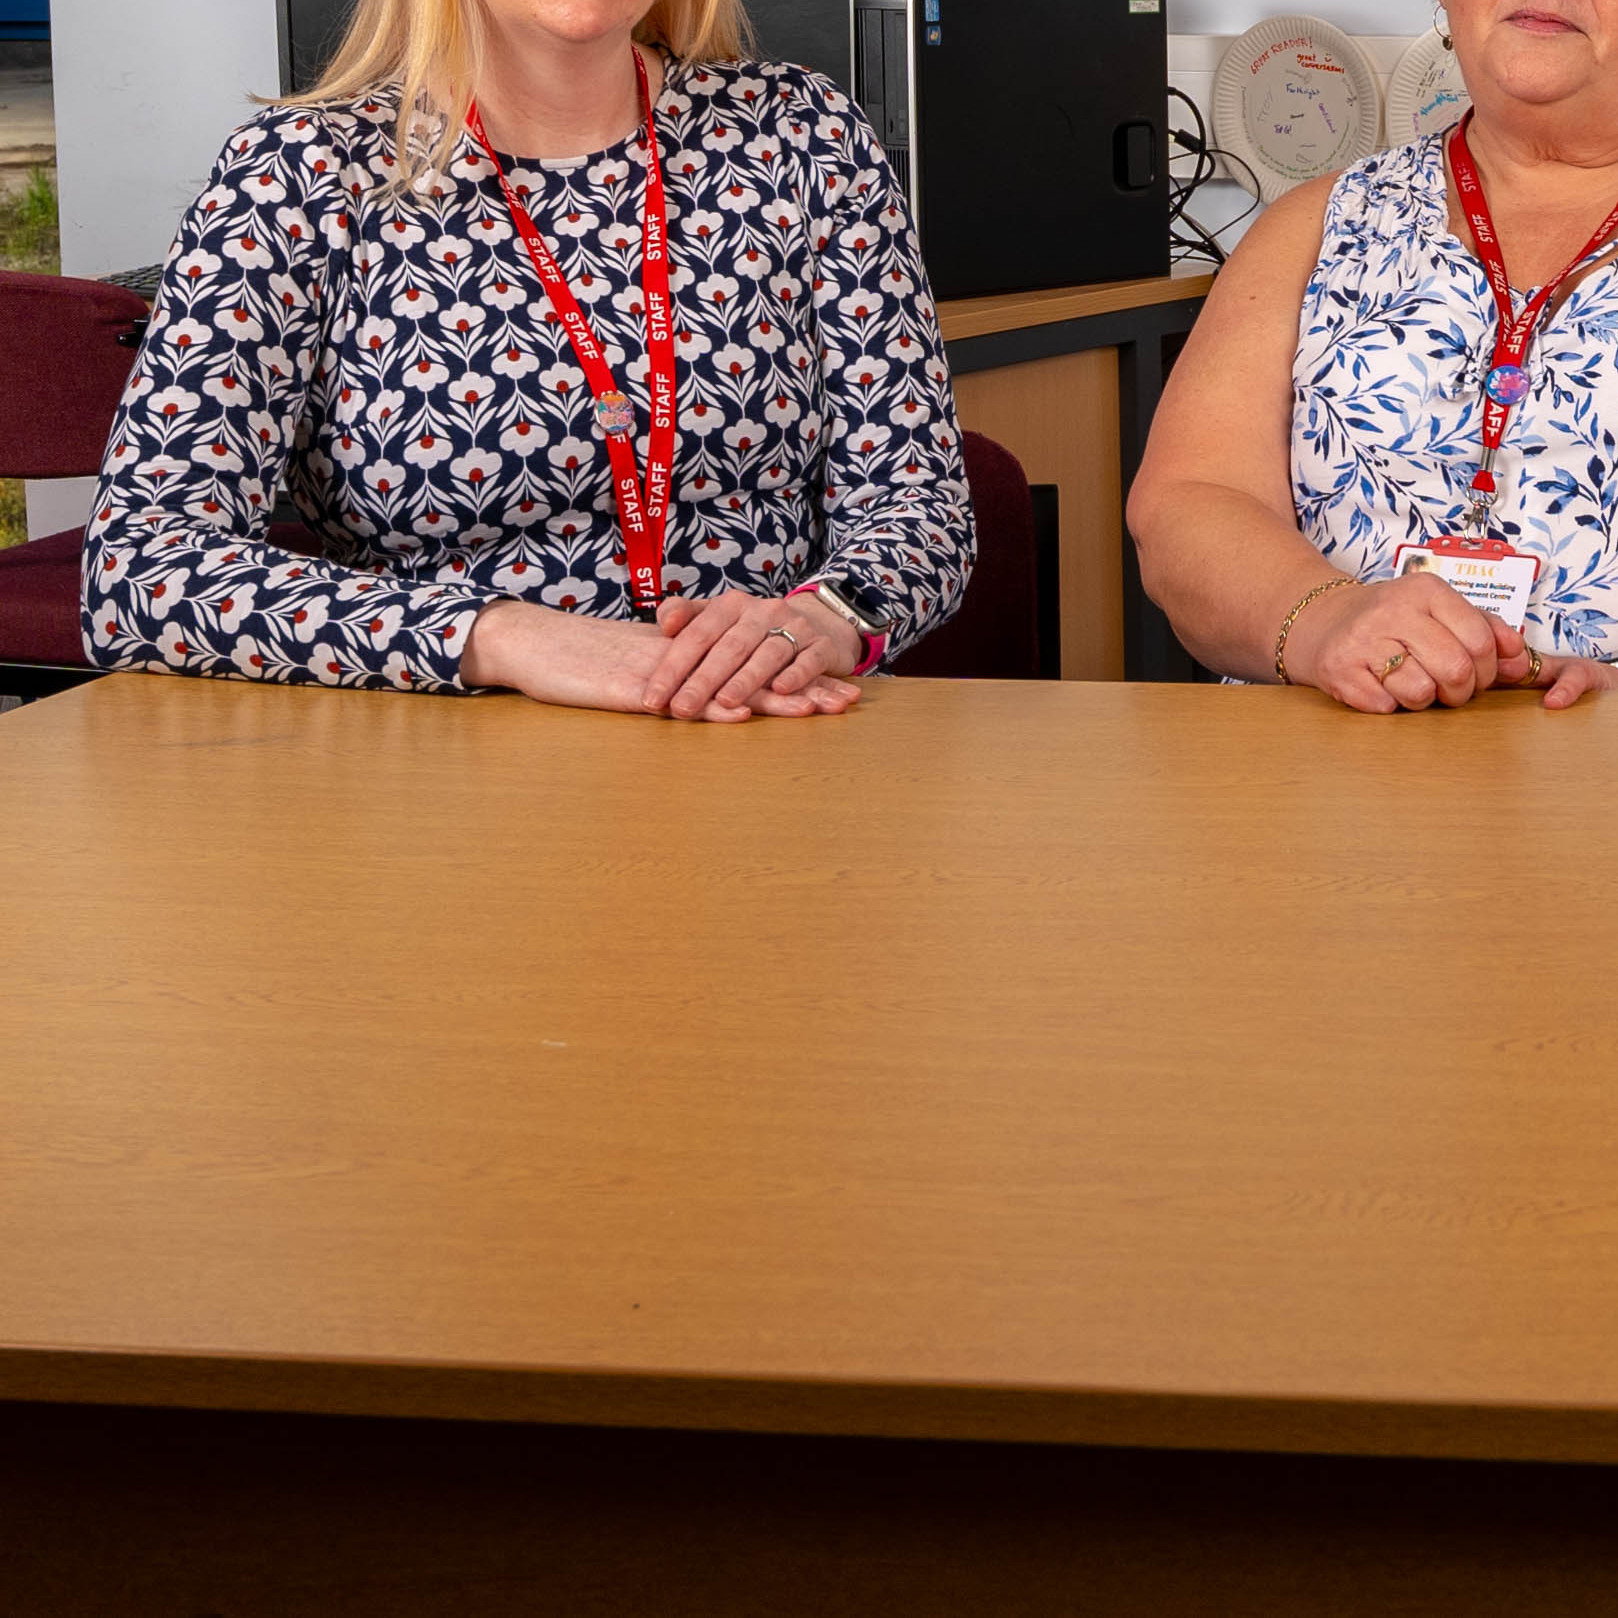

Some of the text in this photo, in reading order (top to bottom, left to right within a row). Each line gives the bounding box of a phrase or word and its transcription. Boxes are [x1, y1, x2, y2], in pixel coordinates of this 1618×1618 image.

[647, 213, 661, 262] STAFF
[1471, 213, 1494, 244] STAFF
[528, 237, 561, 284] STAFF
[1489, 259, 1509, 296] STAFF
[564, 311, 599, 361] STAFF
[649, 291, 668, 342] STAFF
[1506, 310, 1536, 355] STAFF
[655, 372, 671, 428] STAFF
[1486, 402, 1505, 438] AFF
[620, 478, 644, 533] STAFF
[647, 461, 668, 518] STAFF
[1475, 580, 1489, 589] and
[1489, 582, 1516, 593] Building
